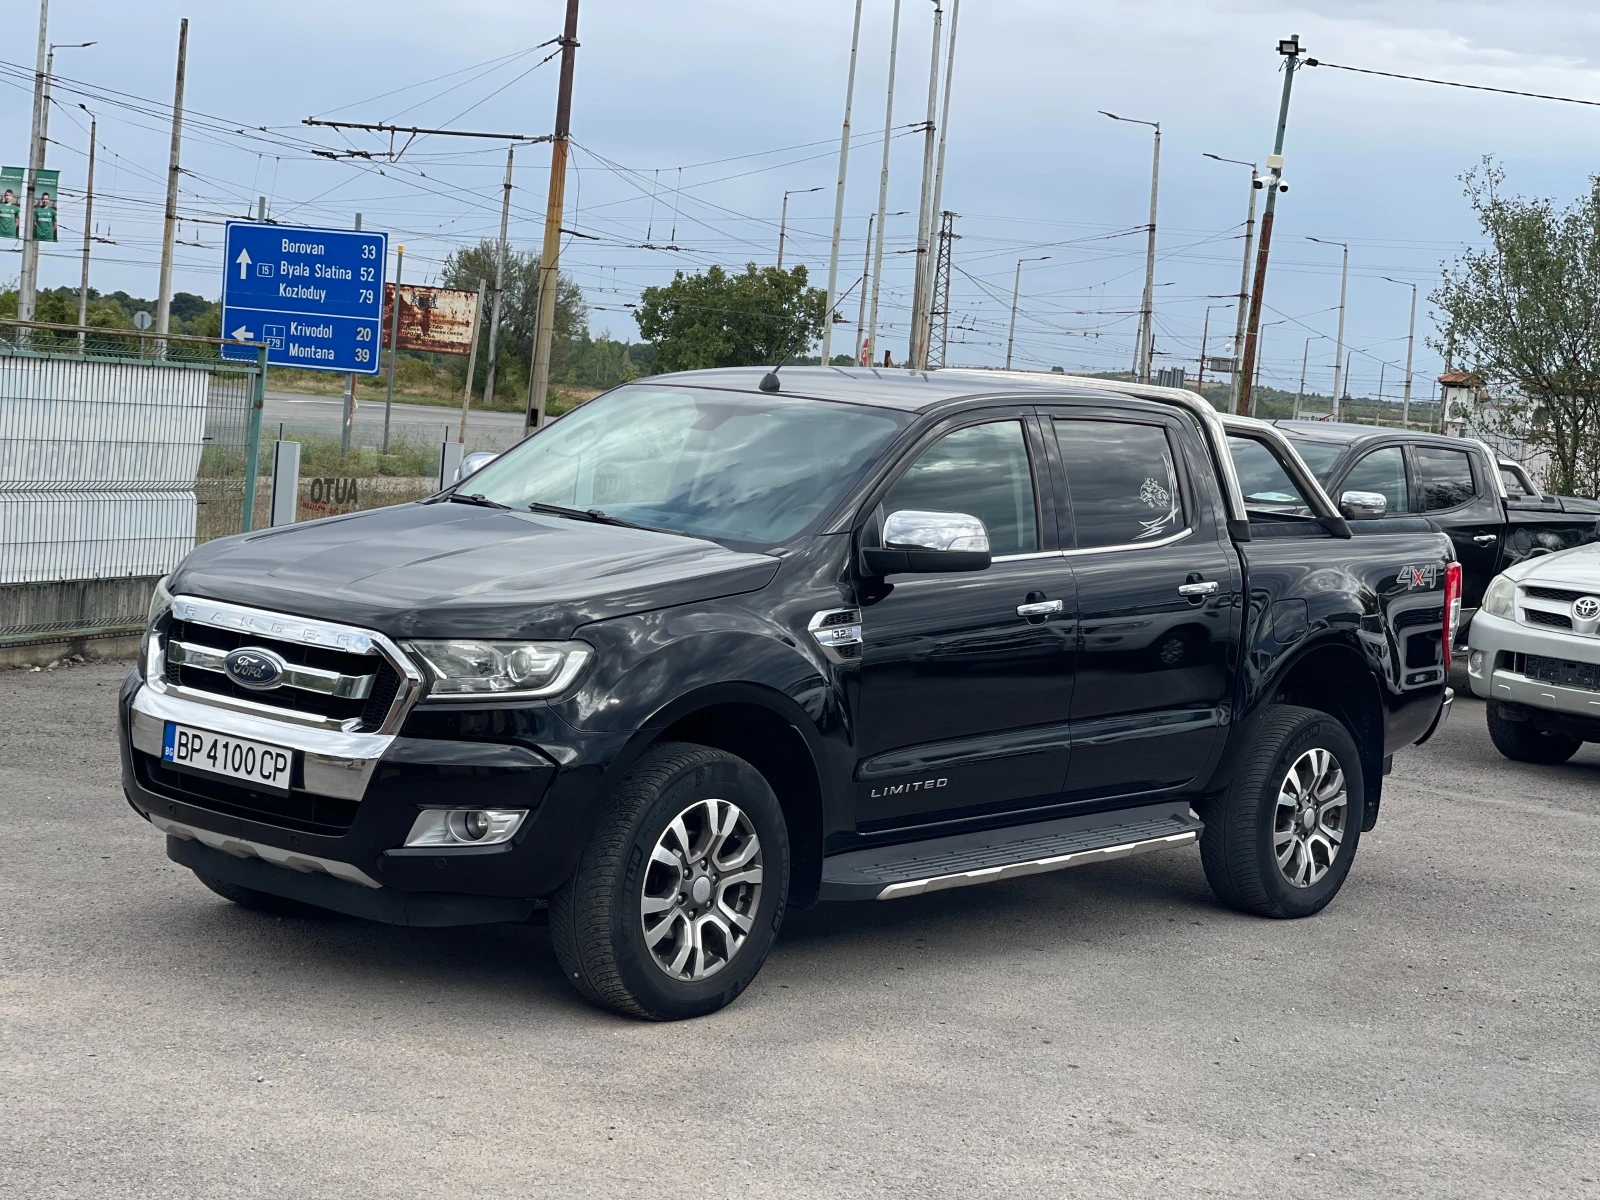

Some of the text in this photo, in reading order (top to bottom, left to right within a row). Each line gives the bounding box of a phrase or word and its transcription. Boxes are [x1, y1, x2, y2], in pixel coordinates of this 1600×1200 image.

[281, 238, 376, 259] Borovan 33
[261, 266, 270, 275] 15
[280, 261, 375, 282] Byala Slatina 52
[279, 282, 374, 304] Kozloduy 79
[290, 321, 372, 342] Krivodol 20
[267, 338, 281, 348] E79
[288, 342, 370, 363] Montana 39
[184, 605, 353, 646] RANGER
[233, 655, 266, 679] Ford
[165, 746, 174, 756] BG
[177, 730, 288, 782] BP 4100 CP
[870, 778, 948, 798] LIMITED
